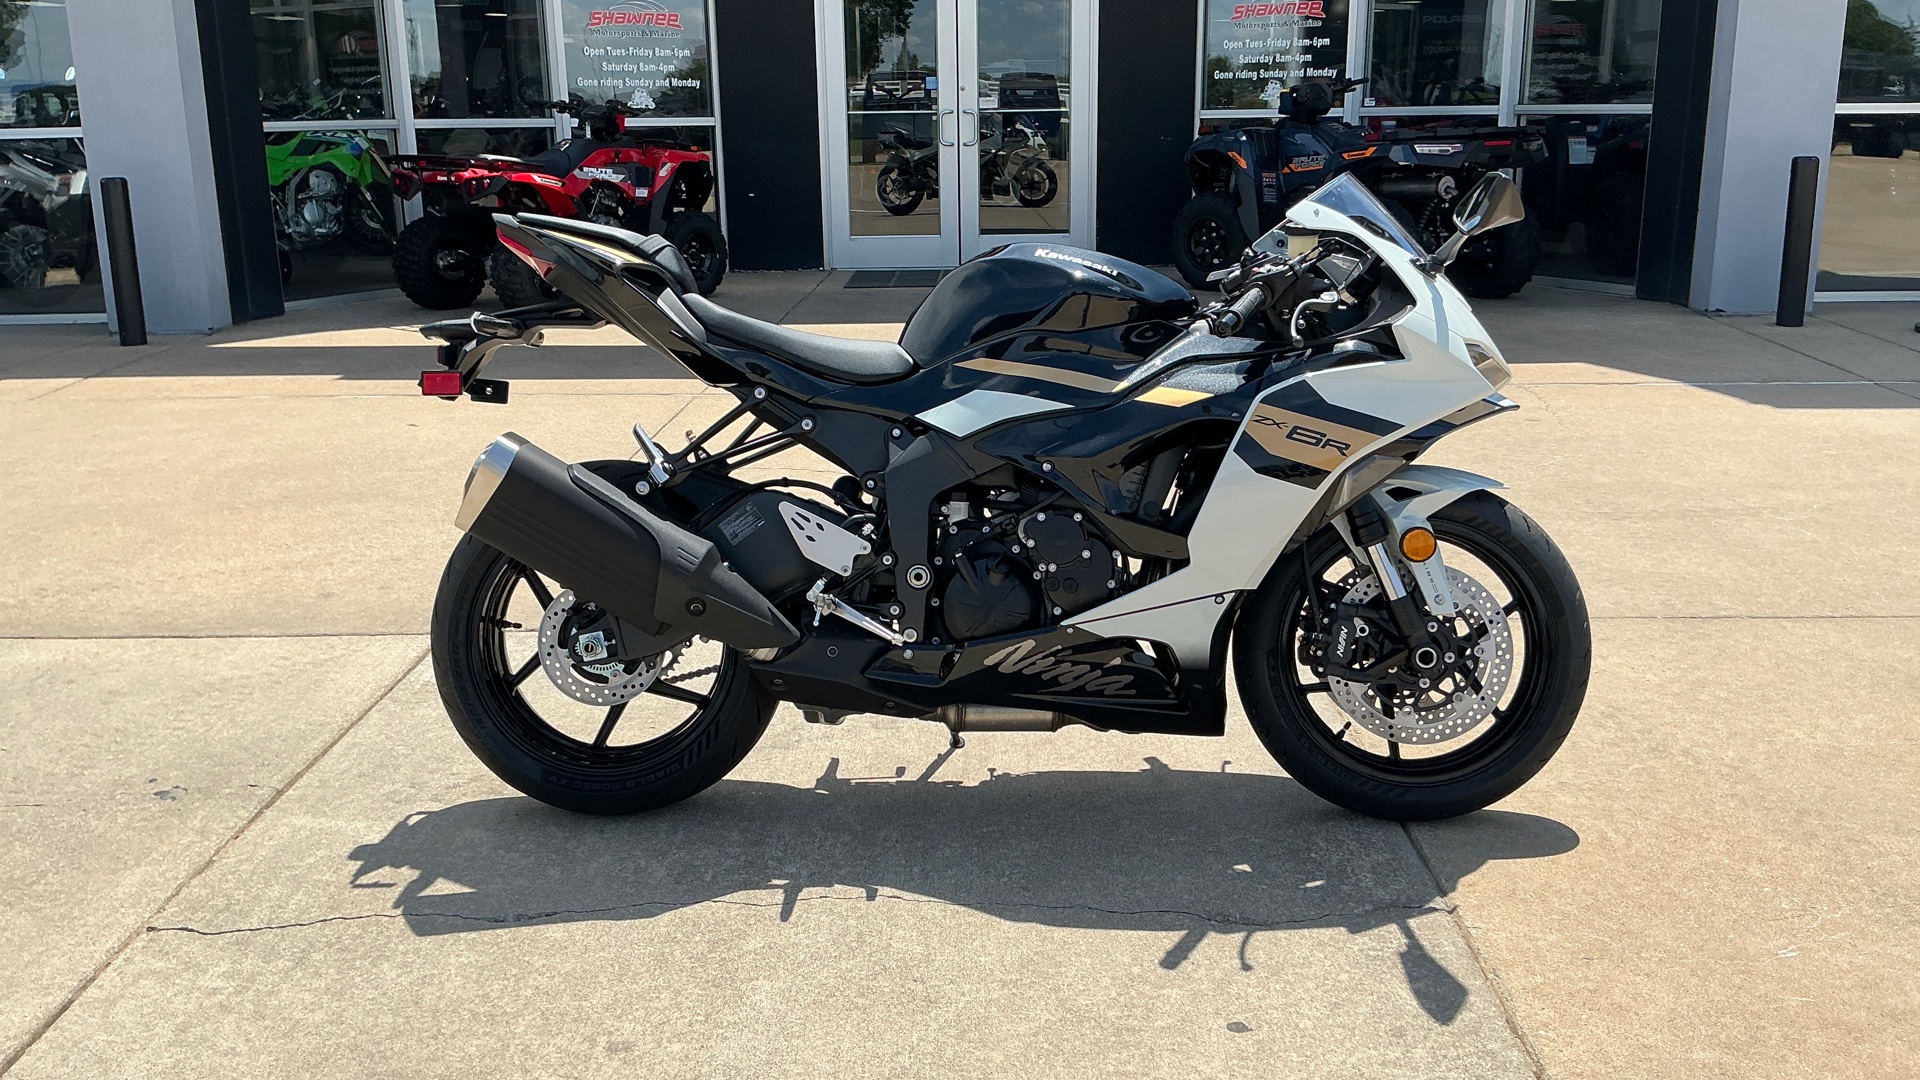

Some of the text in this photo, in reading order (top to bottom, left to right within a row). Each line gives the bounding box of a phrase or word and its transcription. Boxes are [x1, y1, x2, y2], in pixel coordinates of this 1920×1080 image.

[1233, 21, 1282, 30] Motorsports
[1291, 19, 1322, 28] Marine
[592, 29, 642, 39] Motorsports
[652, 30, 681, 38] Marine
[1224, 37, 1330, 50] Open Tues-Friday 8am-6pm
[584, 47, 690, 58] Open Tues-Friday 8am-6pm
[1238, 53, 1312, 66] Saturday 8am-4pm
[602, 62, 675, 74] Saturday 8am-4pm
[1214, 68, 1338, 80] Gone riding Sunday and Monday
[578, 77, 700, 89] Gone riding Sunday and Monday
[1292, 155, 1326, 164] BRUTE
[1034, 248, 1119, 276] Kawasaki
[1250, 414, 1352, 458] ZX-6R
[983, 638, 1136, 695] Ninja
